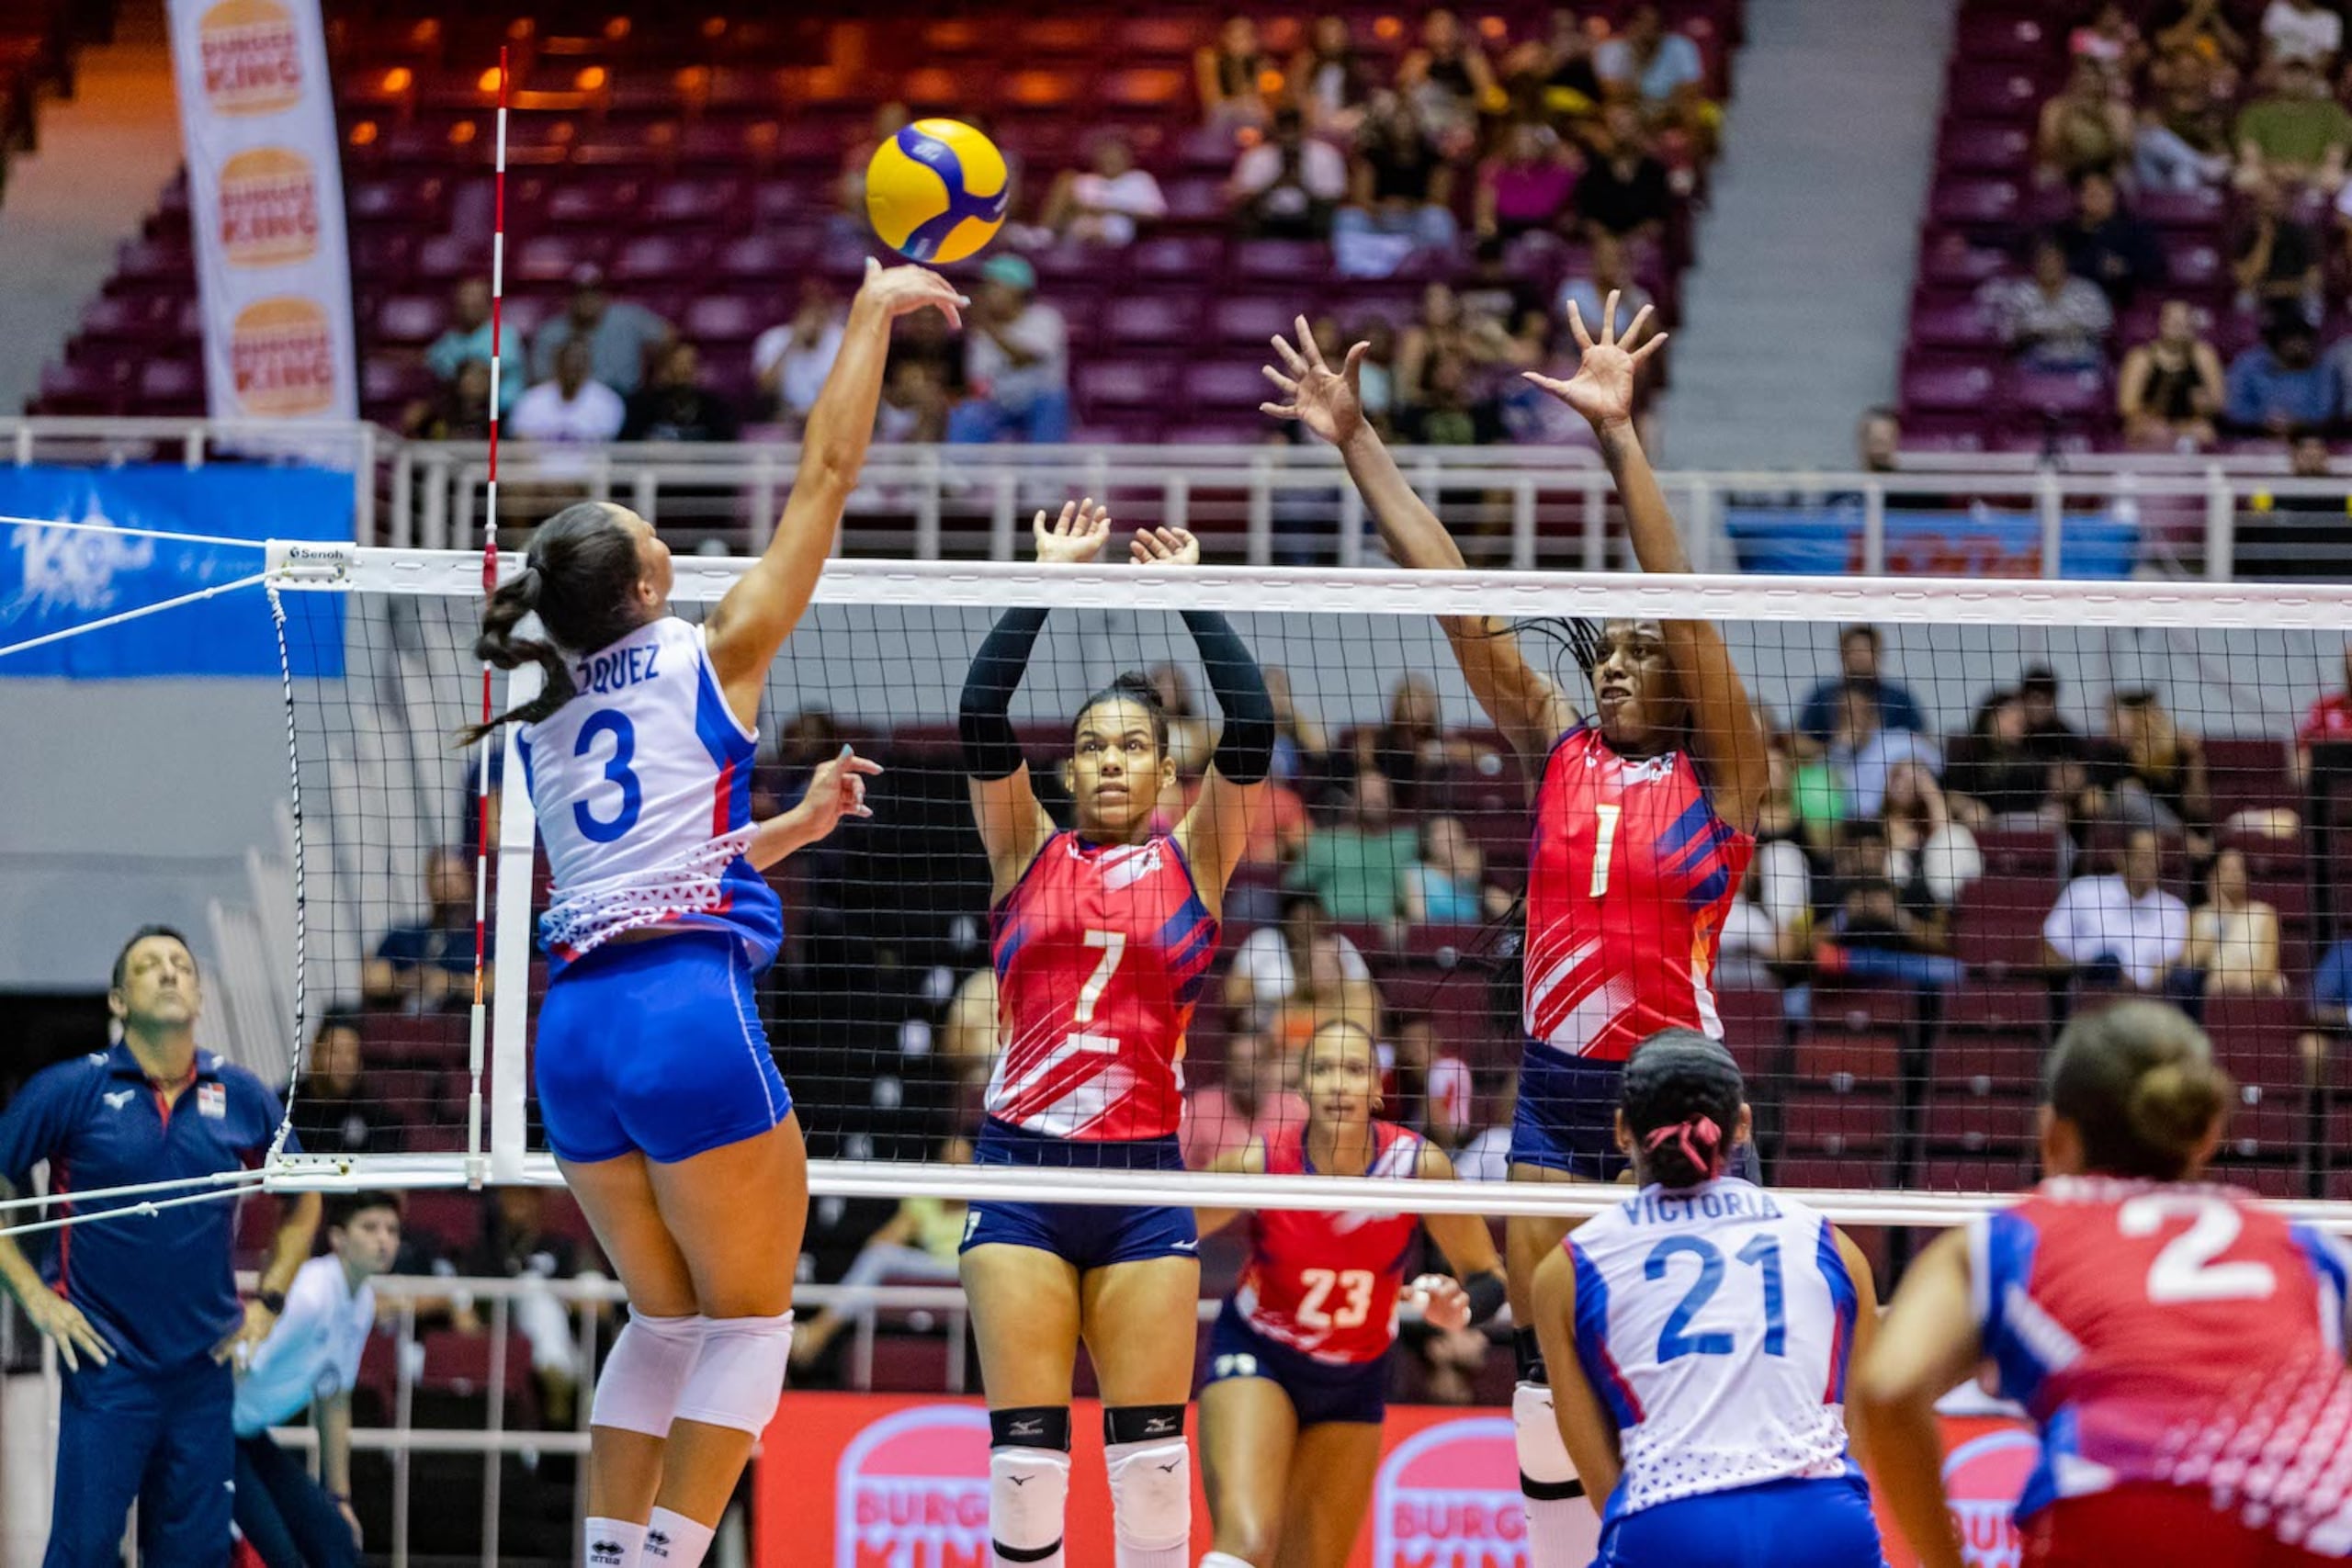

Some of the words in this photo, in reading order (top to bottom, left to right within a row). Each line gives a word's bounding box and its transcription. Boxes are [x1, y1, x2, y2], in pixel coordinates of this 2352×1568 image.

[301, 549, 344, 559] Senoh
[574, 644, 660, 697] ZQUEZ
[573, 708, 642, 843] 3
[1589, 803, 1621, 897] 1
[1074, 929, 1126, 1022] 7
[1623, 1193, 1784, 1225] VICTORIA
[2118, 1194, 2276, 1304] 2
[1295, 1268, 1375, 1329] 23
[1644, 1232, 1787, 1364] 21
[855, 1490, 989, 1529] BURG
[1393, 1502, 1529, 1542] BURG
